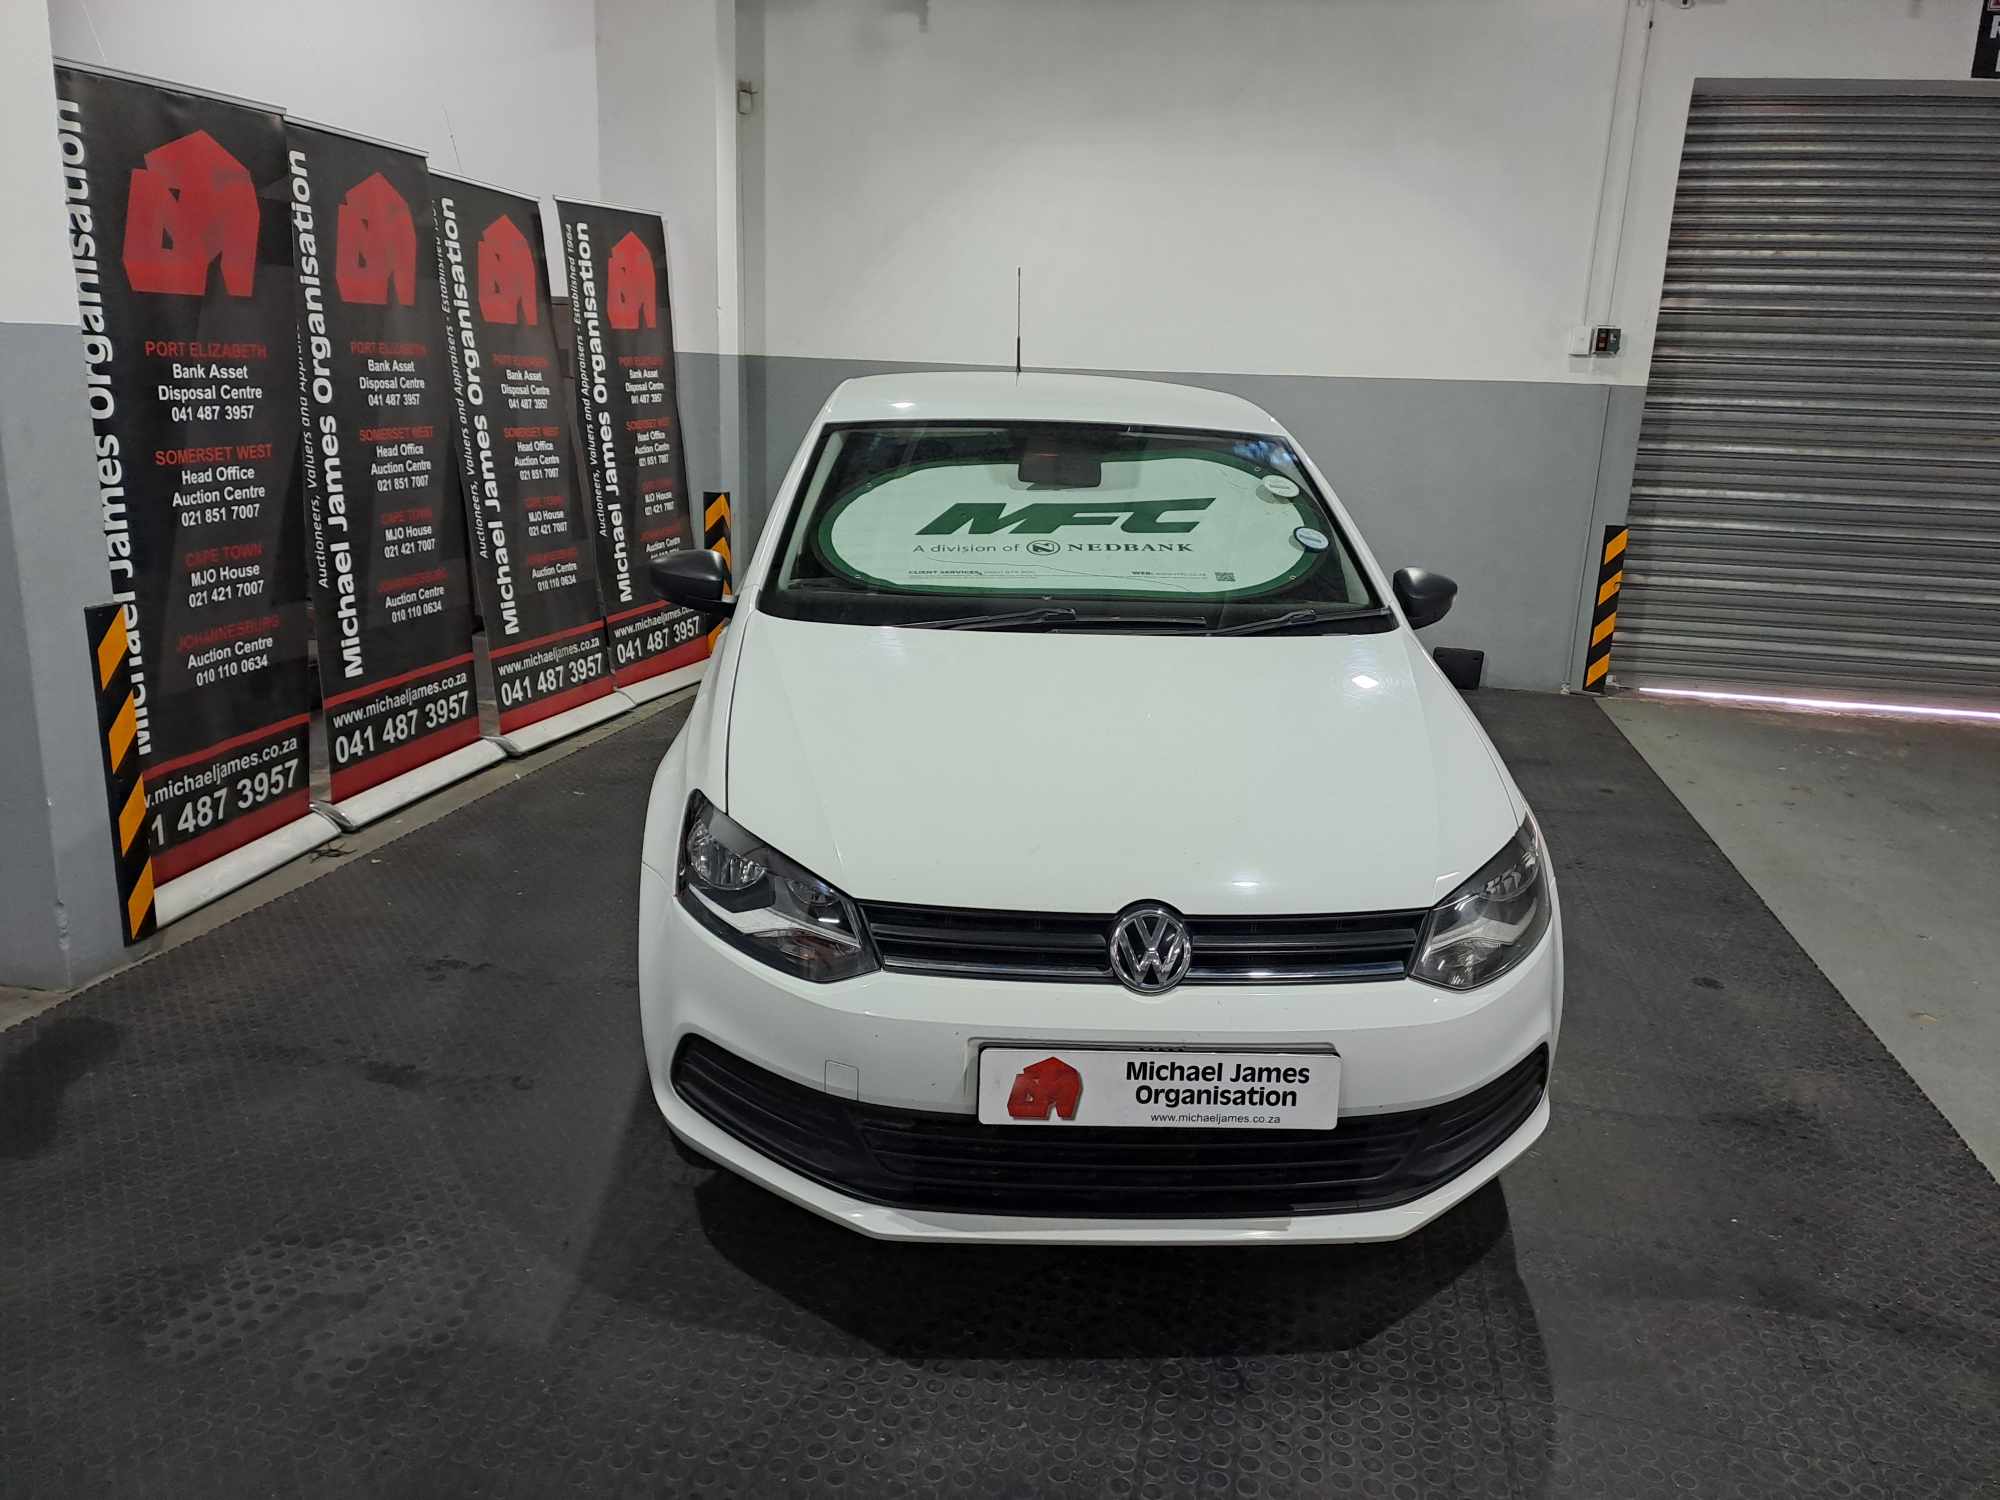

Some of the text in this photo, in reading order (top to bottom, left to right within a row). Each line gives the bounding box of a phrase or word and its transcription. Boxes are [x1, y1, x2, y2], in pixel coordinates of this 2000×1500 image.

[144, 341, 267, 359] PORT ELIZABETH
[172, 363, 248, 379] Bank Asset
[368, 359, 415, 372] Bank Asset
[158, 385, 263, 403] Disposal Centre
[359, 377, 424, 391] Disposal Centre
[368, 395, 383, 406] 041
[385, 394, 400, 406] 487
[455, 398, 468, 424] and
[582, 398, 593, 421] and
[171, 405, 254, 422] 041 487 3957
[289, 150, 364, 679] Michael James Organisation
[441, 197, 520, 635] Michael James Organisation
[577, 222, 632, 602] Michael James Organisation
[155, 444, 272, 466] SOMERSET WEST
[304, 431, 317, 489] Valuers
[376, 443, 424, 458] Head Office
[460, 427, 475, 475] Valuers
[182, 466, 255, 485] Head Office
[371, 459, 431, 475] Auction Centre
[377, 479, 392, 492] 021
[394, 477, 408, 489] 851
[96, 434, 133, 578] James
[172, 486, 265, 507] Auction Centre
[181, 504, 260, 527] 021 851 7007
[469, 481, 489, 559] Auctioneers,
[914, 497, 1217, 535] MFC
[310, 495, 329, 589] Auctioneers,
[385, 525, 432, 541] MJO House
[384, 546, 399, 558] 021
[400, 543, 415, 555] 421
[913, 544, 925, 552] A
[930, 544, 996, 552] division
[1002, 543, 1020, 552] of
[1067, 543, 1193, 552] NEDBANK
[191, 563, 260, 587] MJO House
[188, 580, 264, 608] 021 421 7007
[385, 586, 445, 609] Auction Centre
[391, 611, 406, 623] 010
[407, 606, 421, 619] 110
[616, 615, 700, 664] 041 487 3957
[187, 636, 273, 669] Auction Centre
[498, 636, 599, 676] www.michaeljames.co.za
[196, 654, 268, 687] 010 110 0634
[501, 653, 602, 706] 041 487 3957
[333, 672, 467, 729] www.michaeljames.co.za
[335, 690, 469, 764] 041 487 3957
[143, 737, 297, 809] .michaeljames.co.za
[177, 788, 228, 833] 487
[236, 759, 299, 809] 3957
[1126, 1061, 1310, 1084] Michael James
[1135, 1084, 1297, 1108] Organisation
[1150, 1113, 1281, 1124] www.michaeljames.co.za
